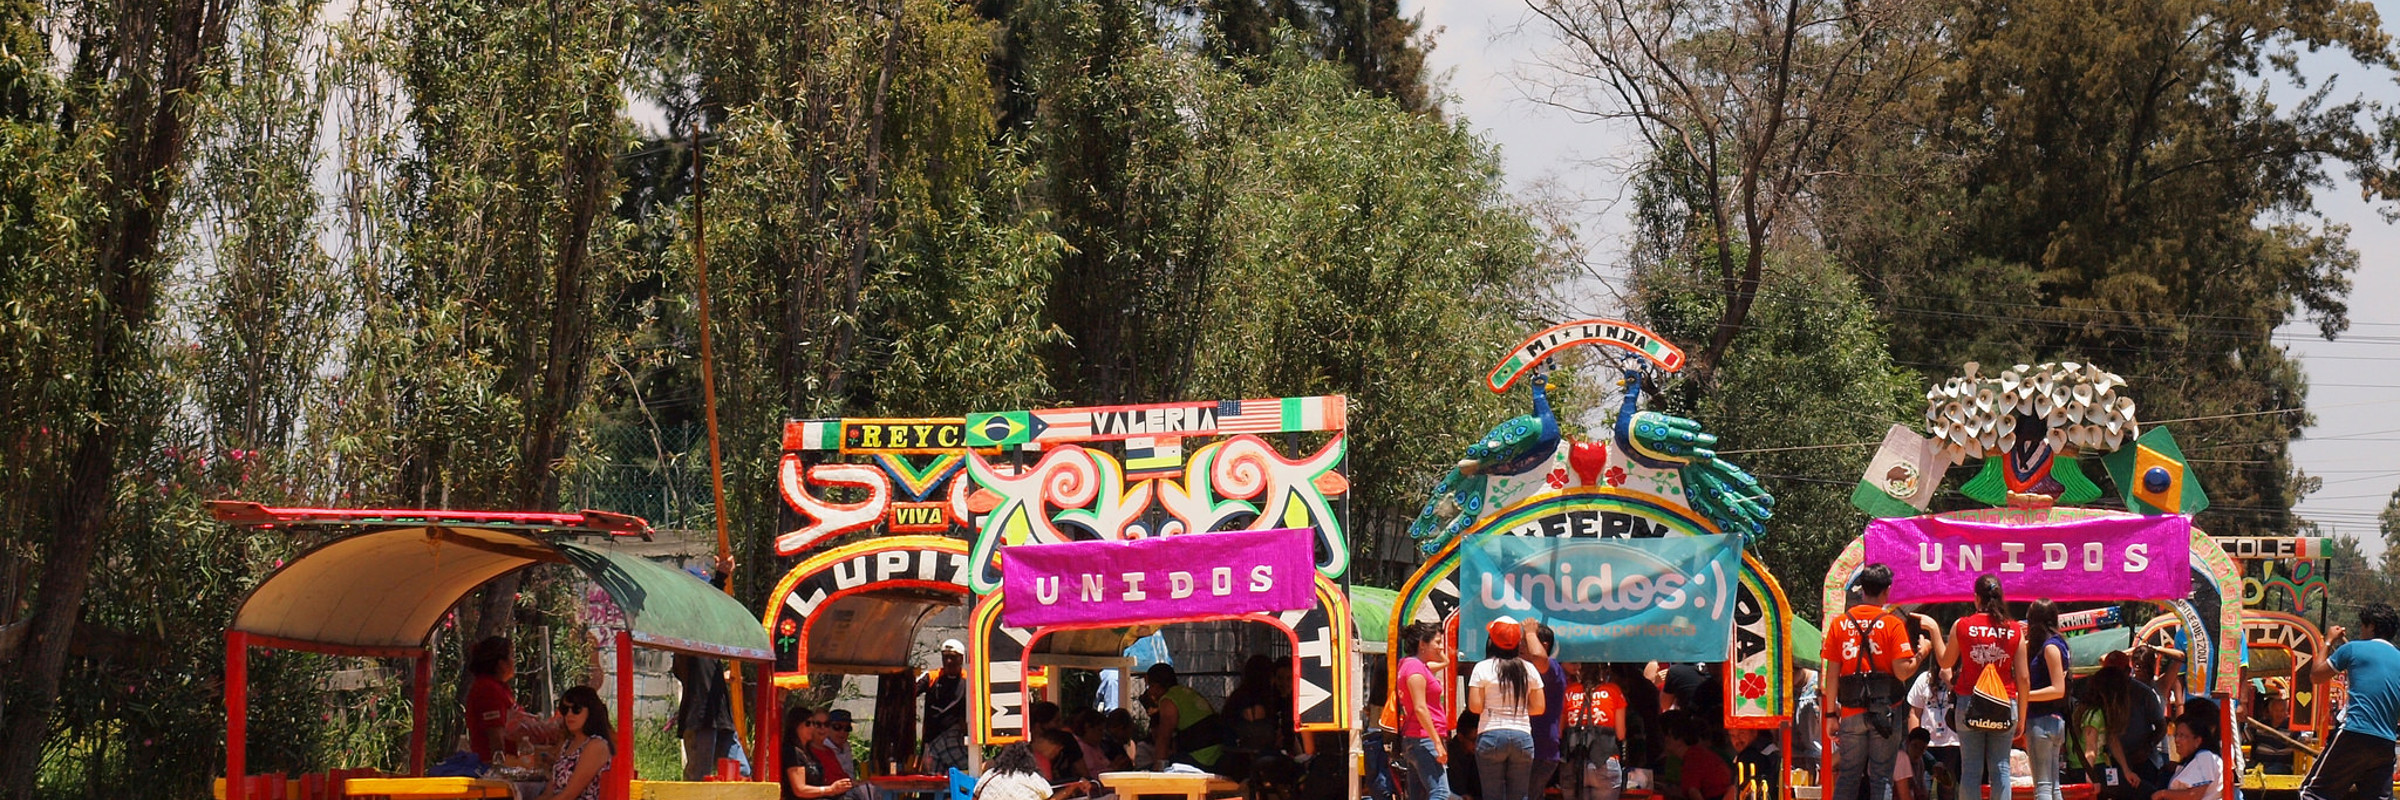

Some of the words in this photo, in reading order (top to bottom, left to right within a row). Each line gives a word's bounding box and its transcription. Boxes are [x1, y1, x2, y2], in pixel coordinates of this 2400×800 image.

[1526, 334, 1559, 357] MI
[1582, 325, 1646, 349] LINDA
[1092, 406, 1217, 435] VALERIA
[861, 425, 967, 448] REYC
[896, 508, 942, 524] VIVA
[1918, 541, 2149, 573] UNIDOS
[2211, 538, 2296, 557] COLE
[1036, 565, 1273, 605] UNIDOS
[2058, 613, 2093, 629] RTHITA
[1968, 625, 2015, 640] STAFF
[1565, 690, 1609, 702] Verno
